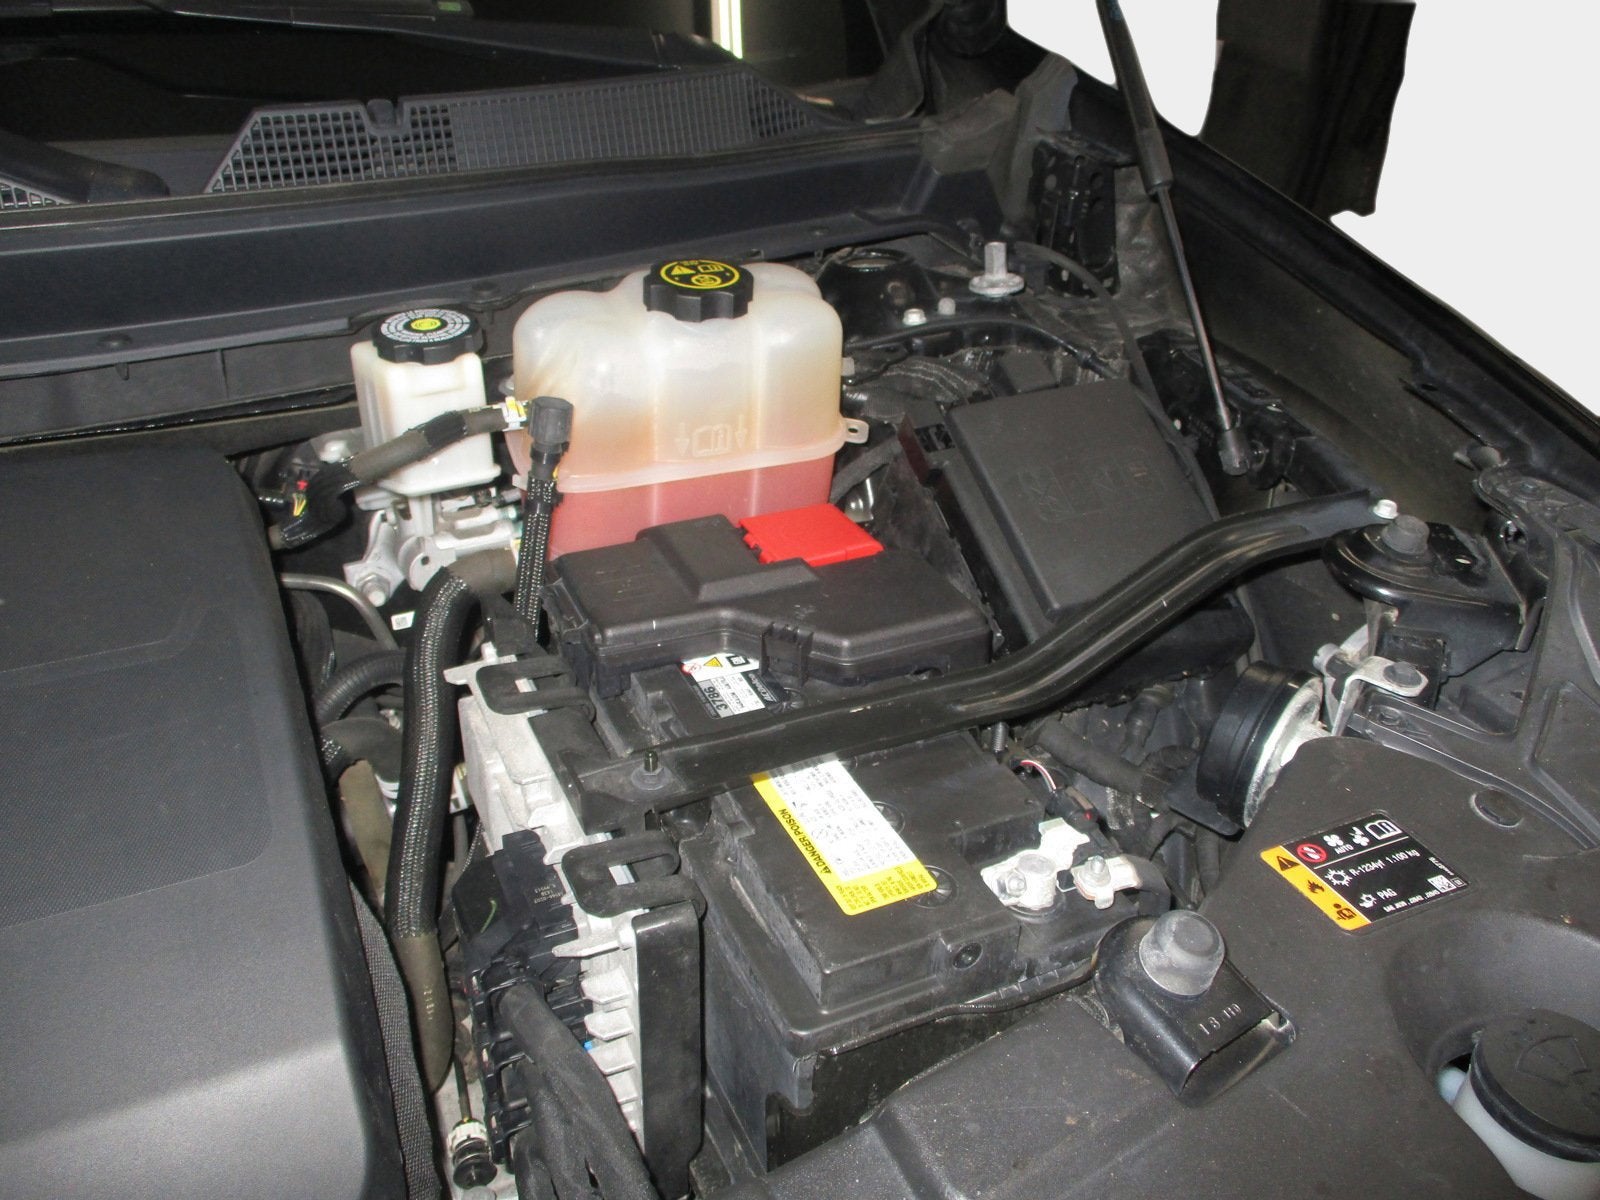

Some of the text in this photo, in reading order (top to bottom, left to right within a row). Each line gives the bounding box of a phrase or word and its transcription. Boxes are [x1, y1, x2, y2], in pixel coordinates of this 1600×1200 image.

[703, 686, 729, 711] 3786
[1334, 844, 1354, 854] AUTO
[1349, 849, 1421, 876] R-1234yf 1.100 kg
[1376, 887, 1397, 900] PAG
